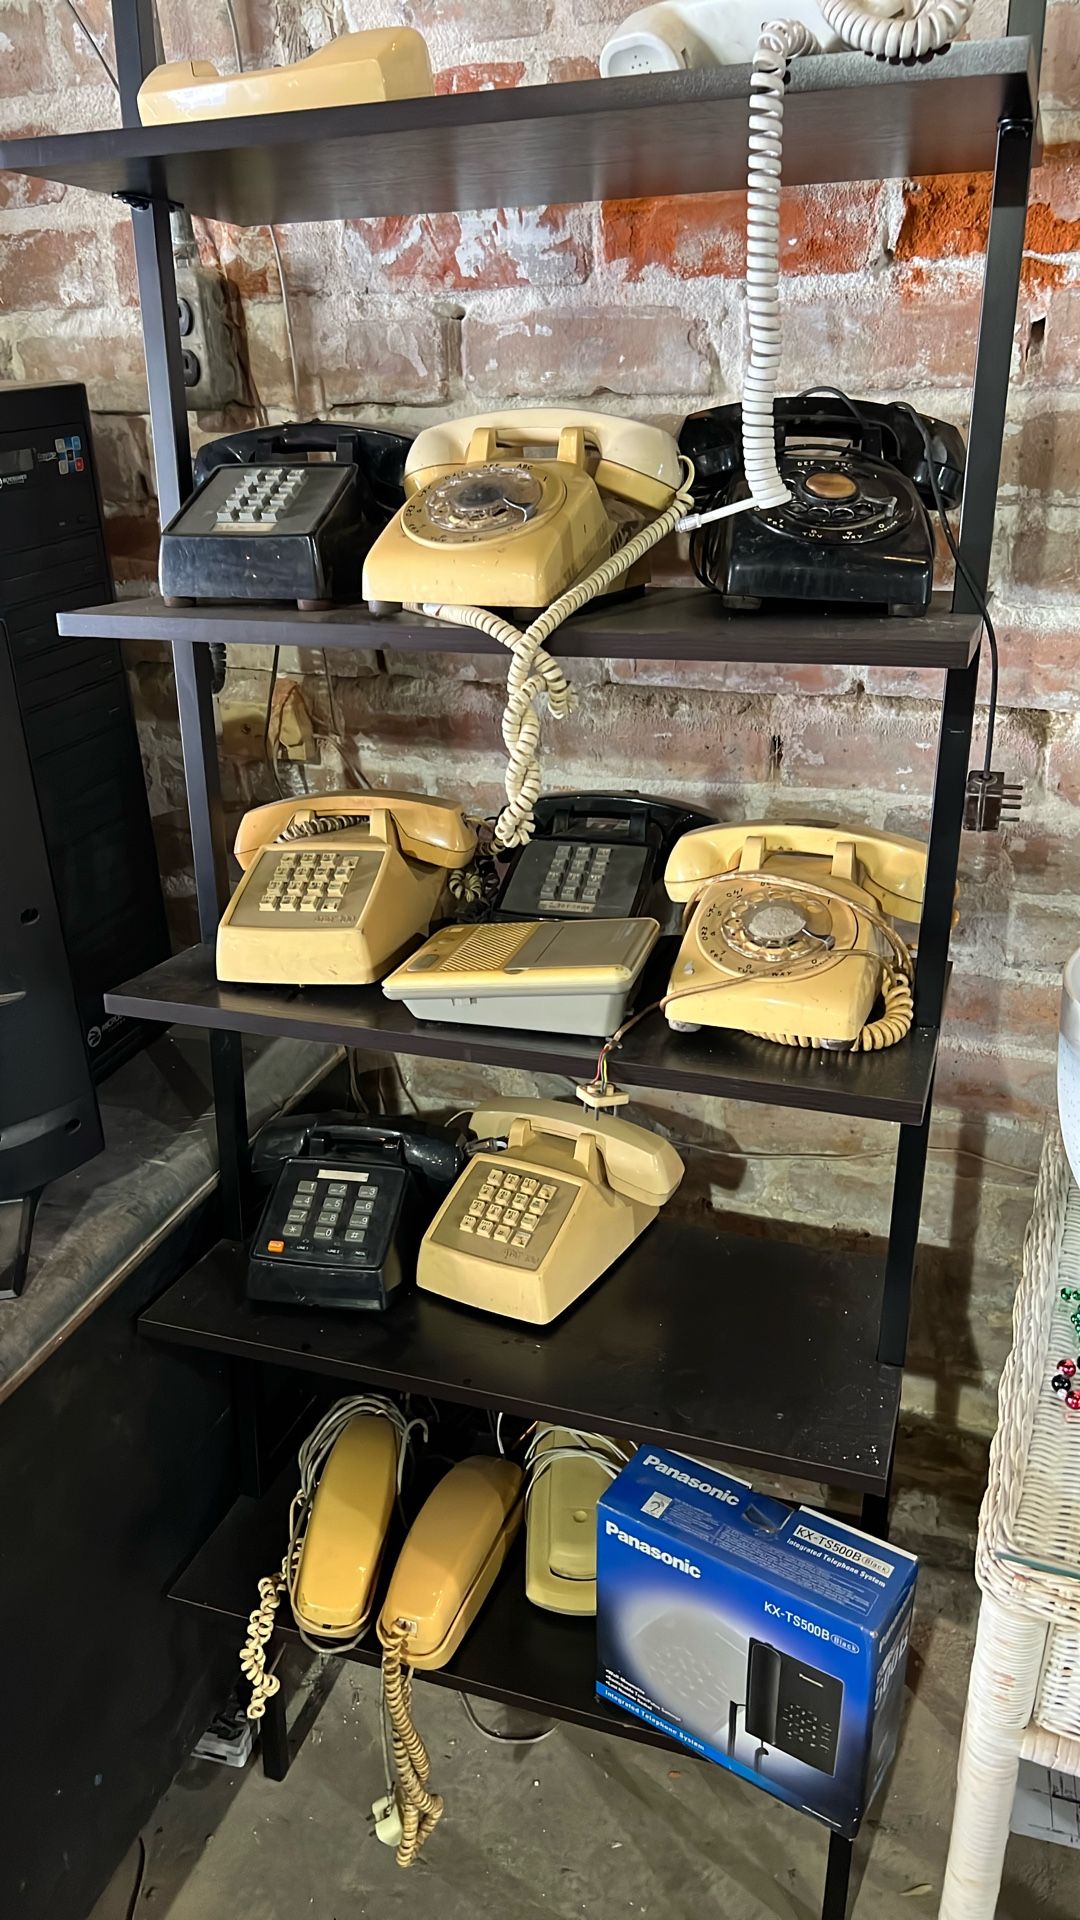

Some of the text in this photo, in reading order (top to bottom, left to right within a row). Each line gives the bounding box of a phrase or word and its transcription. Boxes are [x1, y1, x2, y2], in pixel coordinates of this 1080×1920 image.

[642, 1454, 740, 1506] Panasonic
[605, 1520, 702, 1579] Panasonic
[786, 1538, 886, 1588] Integrated Telephone System
[796, 1526, 862, 1562] KX-TS500B
[763, 1600, 858, 1654] KX-TS500B Black
[605, 1689, 640, 1714] Integrated
[641, 1710, 678, 1735] Telephone
[679, 1732, 705, 1751] System
